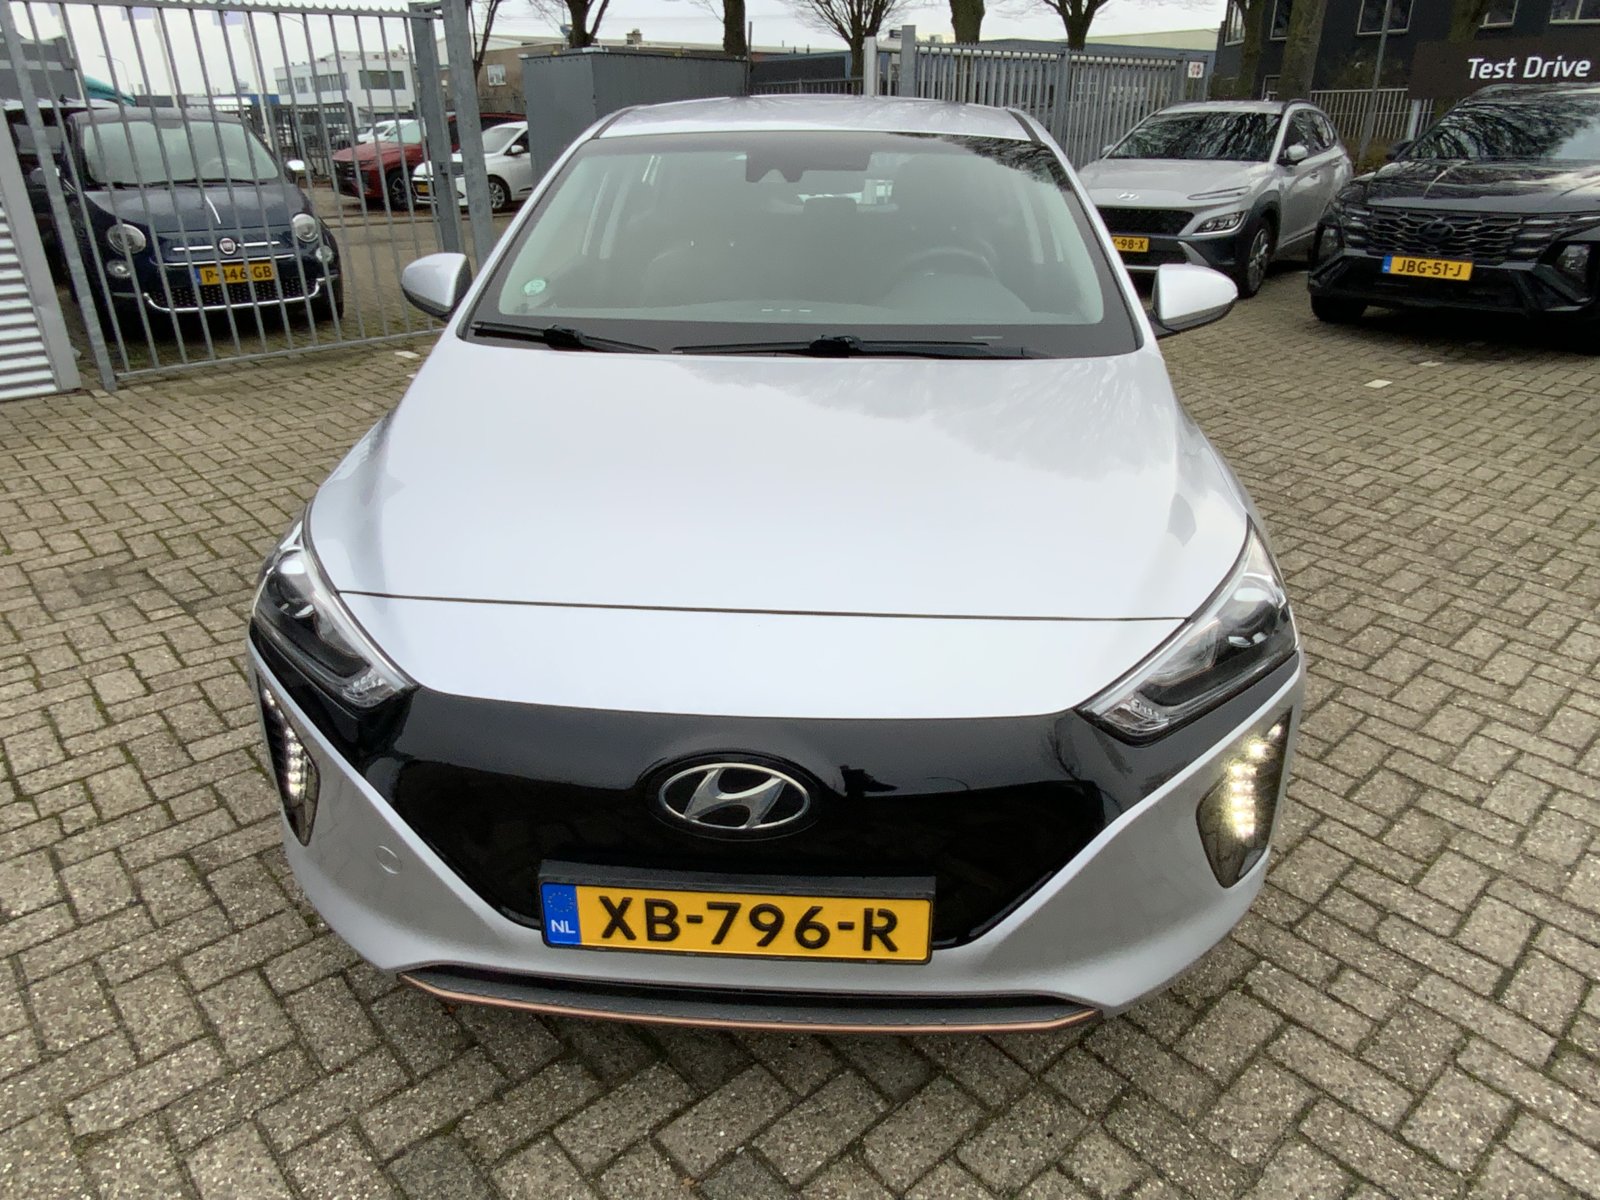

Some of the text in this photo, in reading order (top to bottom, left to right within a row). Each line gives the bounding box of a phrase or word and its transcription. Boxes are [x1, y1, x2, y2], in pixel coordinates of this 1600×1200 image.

[1468, 55, 1591, 79] Test Drive
[204, 265, 272, 282] P-46GB
[1397, 259, 1462, 277] JBG-51-J
[551, 919, 576, 934] NL
[598, 895, 898, 952] XB-796-R
